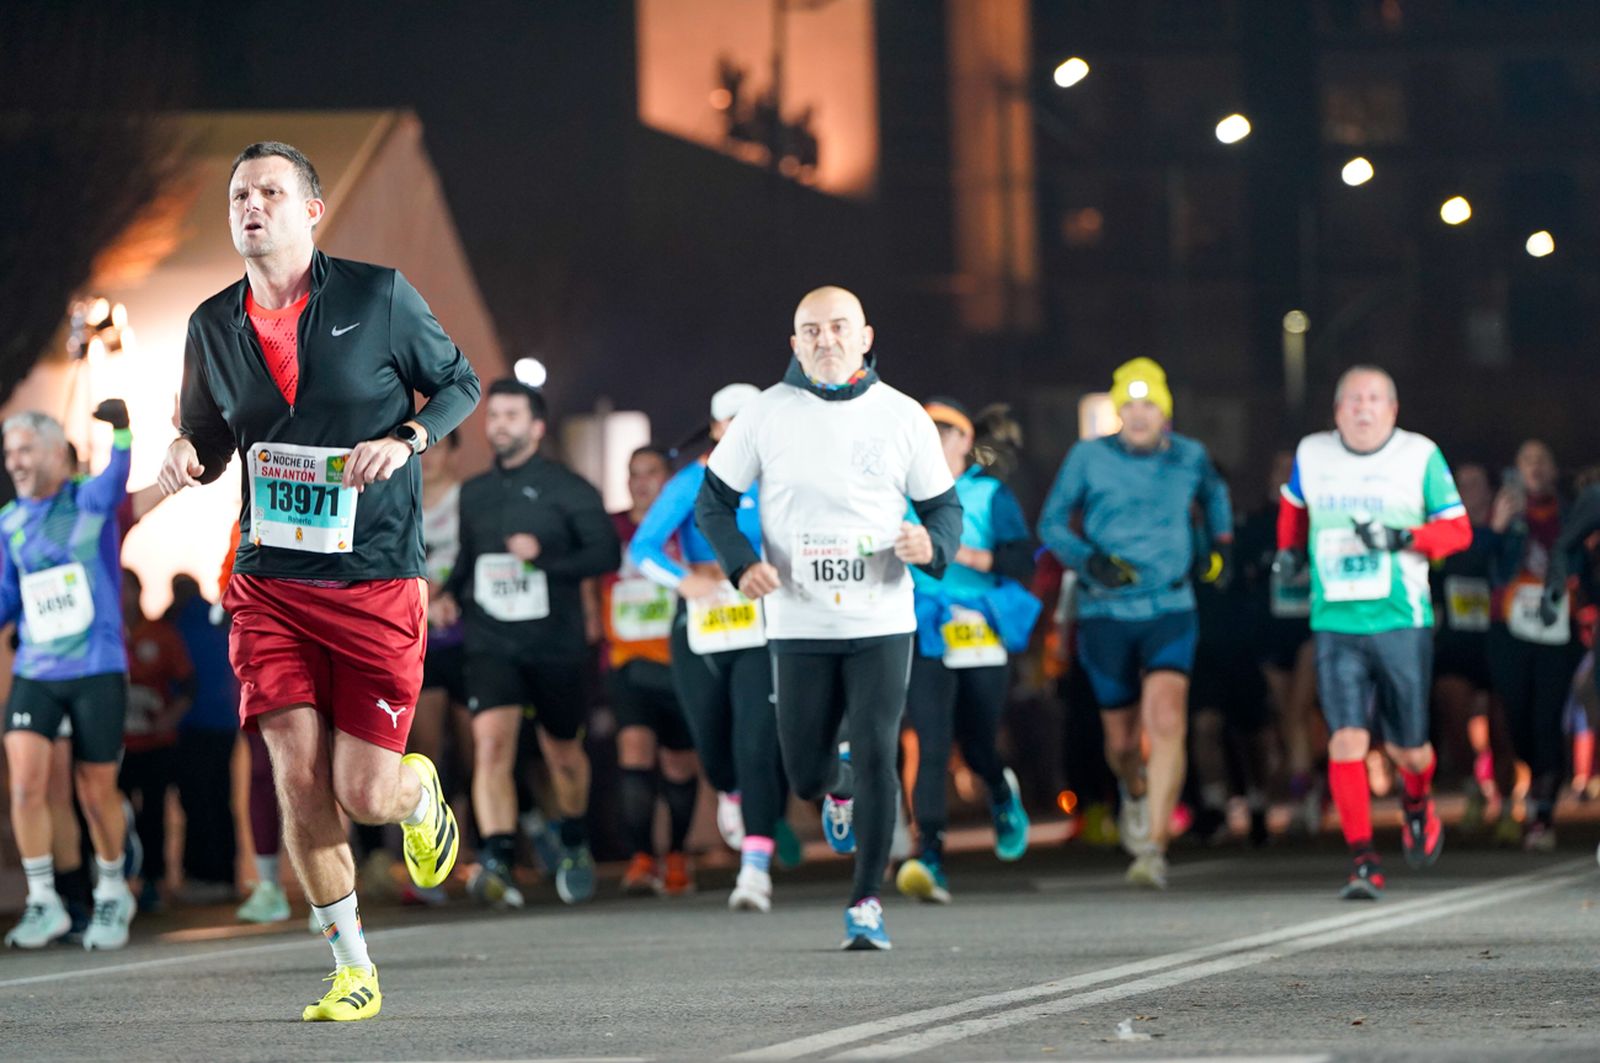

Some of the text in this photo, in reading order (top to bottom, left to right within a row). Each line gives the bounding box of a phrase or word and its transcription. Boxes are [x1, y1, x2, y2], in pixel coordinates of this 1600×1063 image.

[272, 454, 301, 468] NOCHE
[303, 459, 316, 470] DE
[261, 465, 281, 478] SAN
[282, 468, 316, 483] ANTÓN
[266, 480, 340, 517] 13971
[810, 558, 865, 582] 1630
